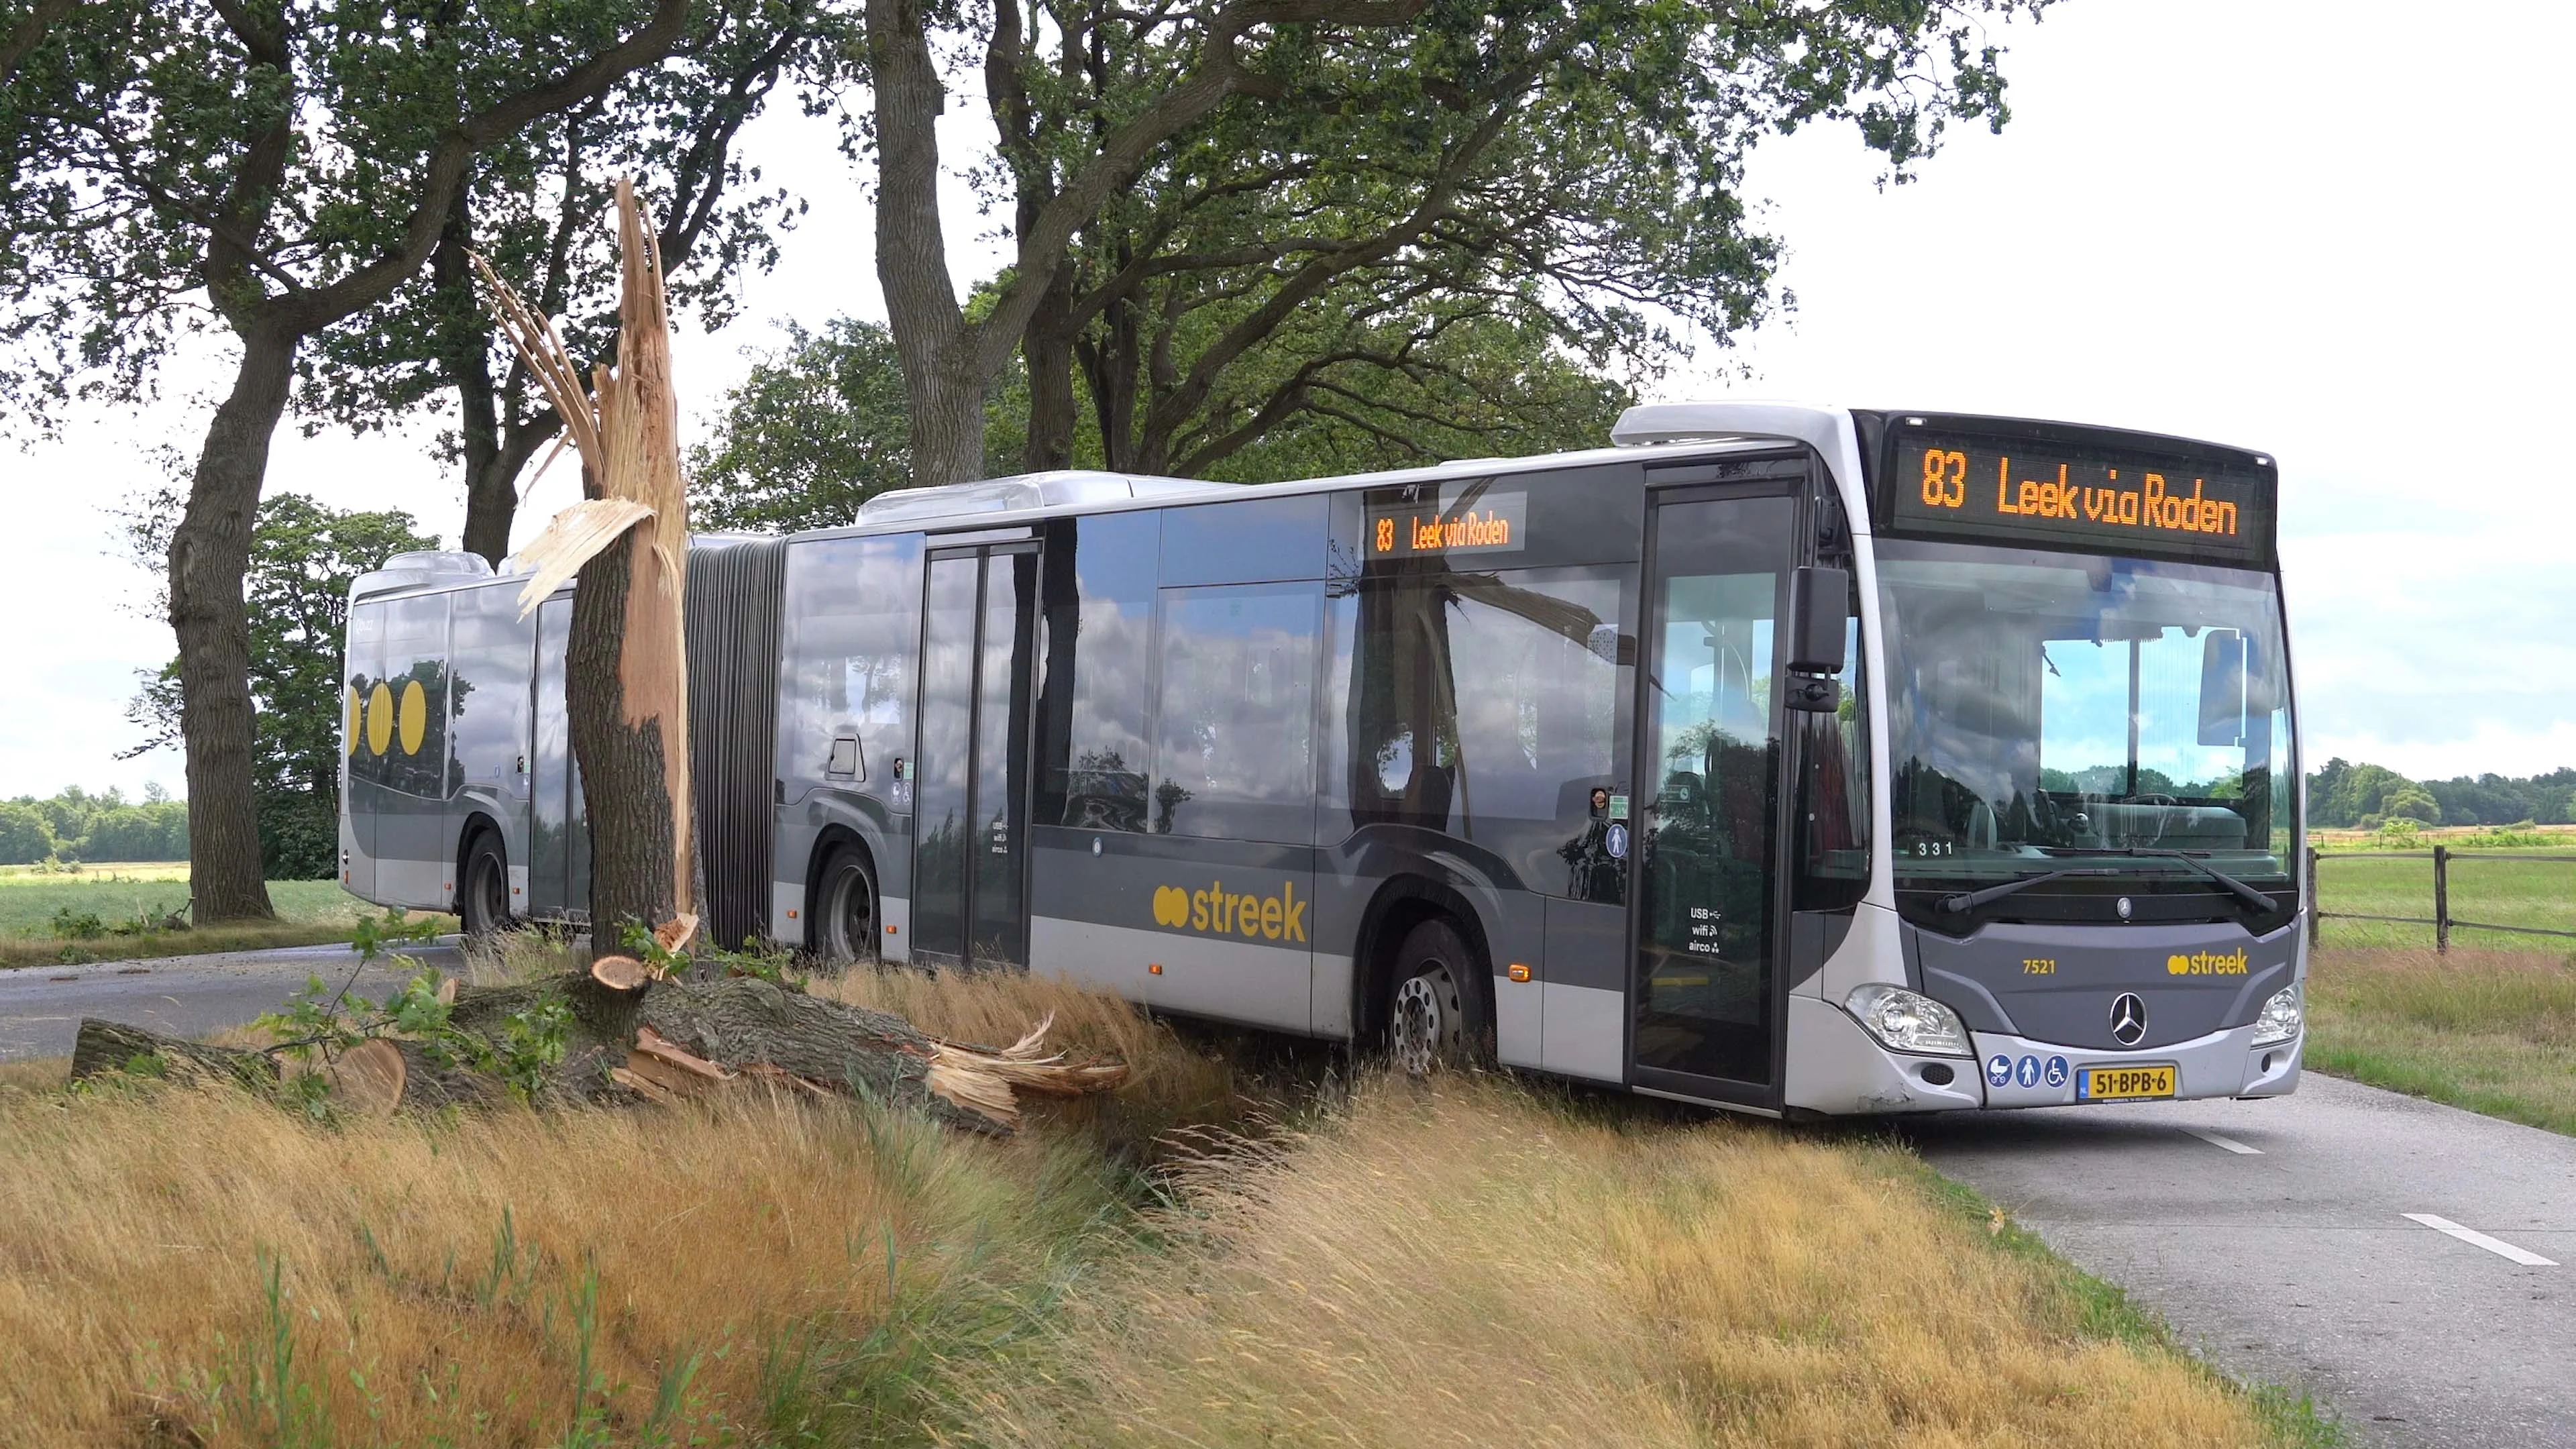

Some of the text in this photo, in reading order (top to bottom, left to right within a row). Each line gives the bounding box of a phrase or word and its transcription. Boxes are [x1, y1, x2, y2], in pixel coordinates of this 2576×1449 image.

[1922, 449, 2237, 535] 83 Leek via Roden
[1377, 511, 1509, 551] 83 Leek via Roden
[1192, 880, 1307, 942] streek
[1690, 907, 1709, 919] USB
[1692, 924, 1708, 936] wifi
[1688, 940, 1710, 952] airco
[2023, 959, 2055, 974] 7521
[2190, 947, 2248, 975] streek
[2096, 1071, 2167, 1094] 51-BPB-6
